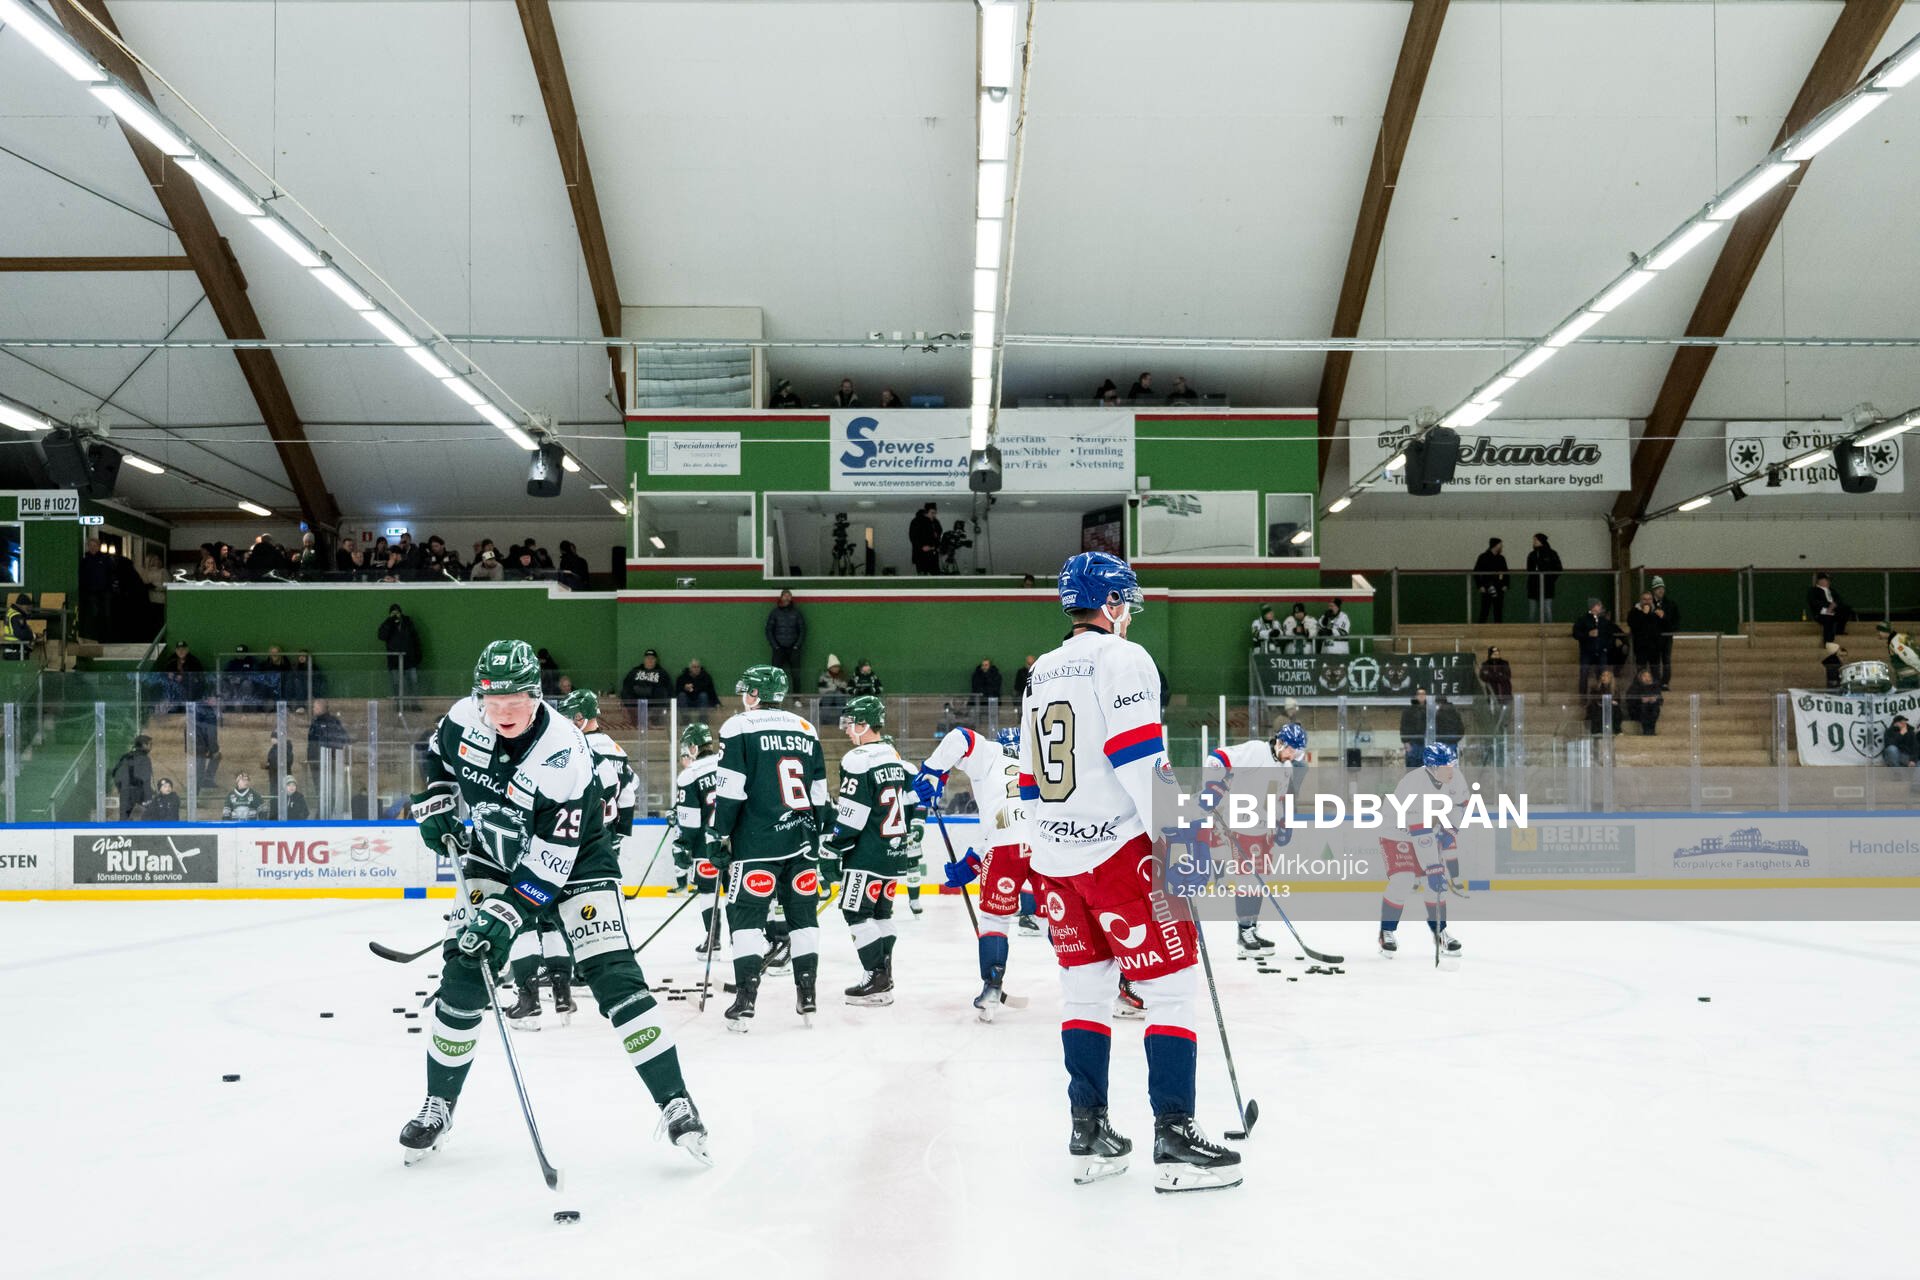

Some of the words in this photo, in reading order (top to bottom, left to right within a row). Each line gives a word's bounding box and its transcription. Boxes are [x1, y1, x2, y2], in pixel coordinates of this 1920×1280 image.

[999, 434, 1046, 443] aserstans
[1002, 447, 1061, 456] ans/Nibbler
[1076, 447, 1124, 457] Trumling
[1457, 437, 1601, 466] ehanda
[1004, 460, 1048, 469] arv/Fräs
[1076, 460, 1124, 470] Svetsning
[1475, 474, 1491, 485] för
[1496, 477, 1511, 486] en
[1515, 475, 1566, 486] starkare
[1569, 474, 1604, 487] bygd!
[21, 498, 41, 510] PUB
[492, 655, 507, 666] 29
[1270, 658, 1316, 669] STOLTHET
[1434, 671, 1444, 680] IS
[1271, 685, 1317, 695] TRADITION
[1798, 695, 1853, 715] Gröna
[760, 735, 814, 756] OHLSSON
[777, 756, 811, 811] 6
[553, 809, 582, 838] 29
[1543, 826, 1620, 843] BEIJER
[92, 836, 132, 854] Glada
[255, 840, 329, 864] TMG
[1850, 840, 1920, 854] Handels
[107, 850, 173, 871] RUTan
[1673, 860, 1733, 871] Korpalycke
[1736, 859, 1792, 870] Fastighets
[1795, 859, 1811, 868] AB
[97, 873, 142, 882] fönsterputs
[145, 873, 150, 881] &
[257, 868, 314, 881] Tingsryds
[318, 867, 356, 877] Måleri
[360, 868, 366, 877] &
[370, 867, 397, 877] Golv
[520, 883, 549, 903] ALWEX
[568, 919, 622, 943] HOLTAB
[625, 1028, 656, 1051] ORRÖ
